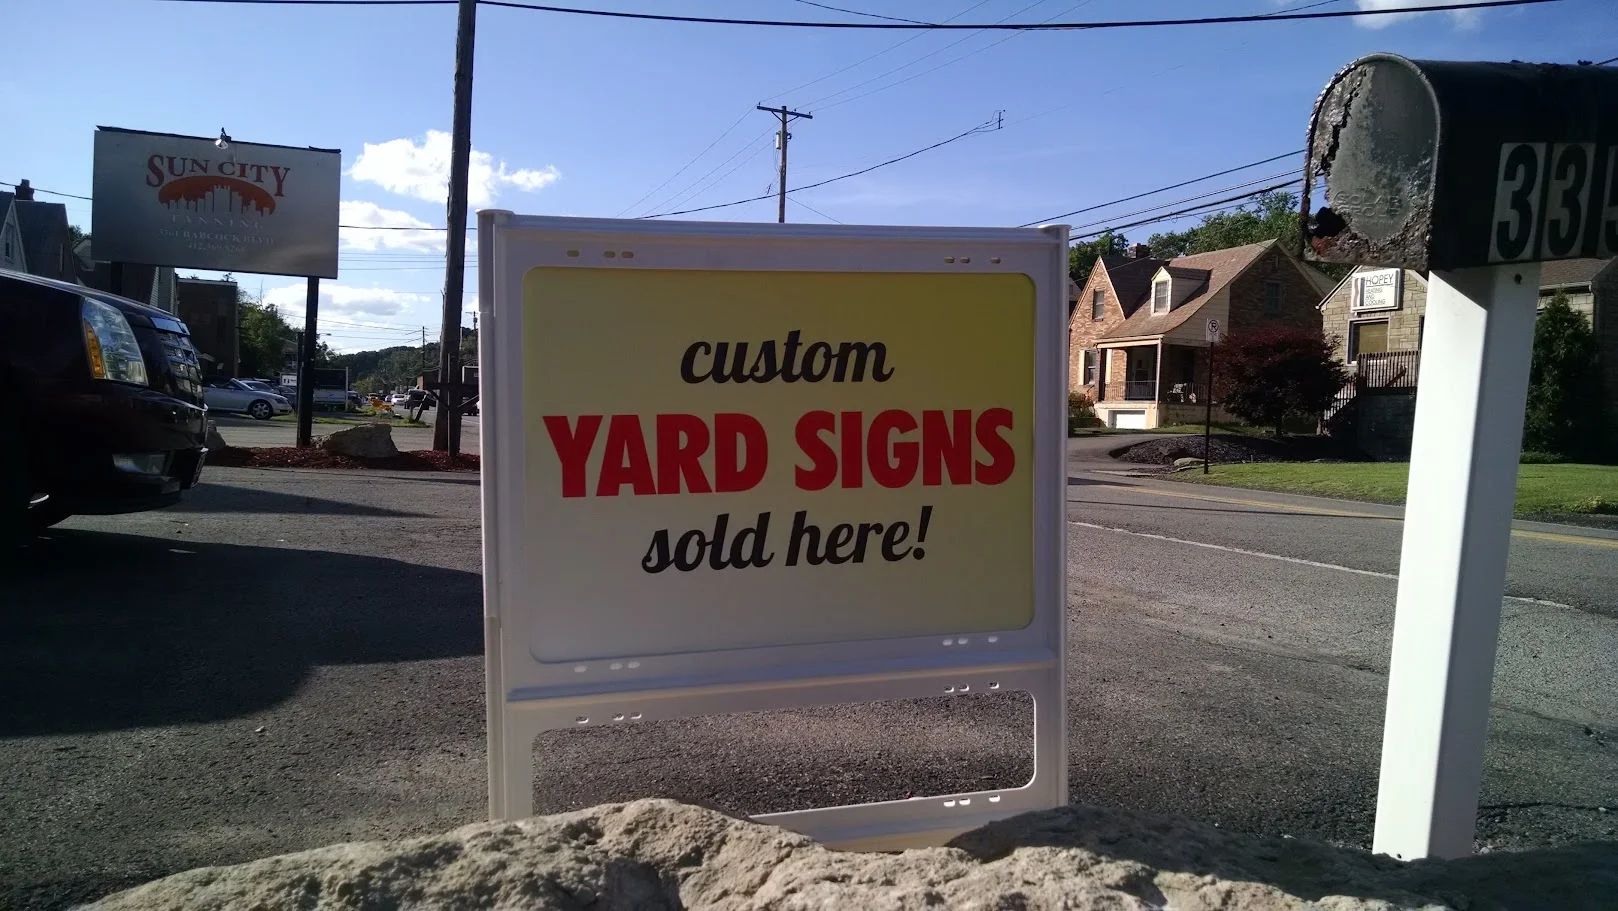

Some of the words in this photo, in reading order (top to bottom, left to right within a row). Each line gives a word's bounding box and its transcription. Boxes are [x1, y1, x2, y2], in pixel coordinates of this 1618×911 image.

[146, 154, 209, 188] SUN
[217, 161, 291, 197] CITY
[1495, 144, 1618, 259] 33
[1365, 273, 1394, 285] HOPEY
[679, 330, 895, 385] custom
[543, 413, 769, 498] YARD
[795, 407, 1016, 492] SIGNS
[641, 512, 774, 574] sold
[785, 505, 933, 567] here!
